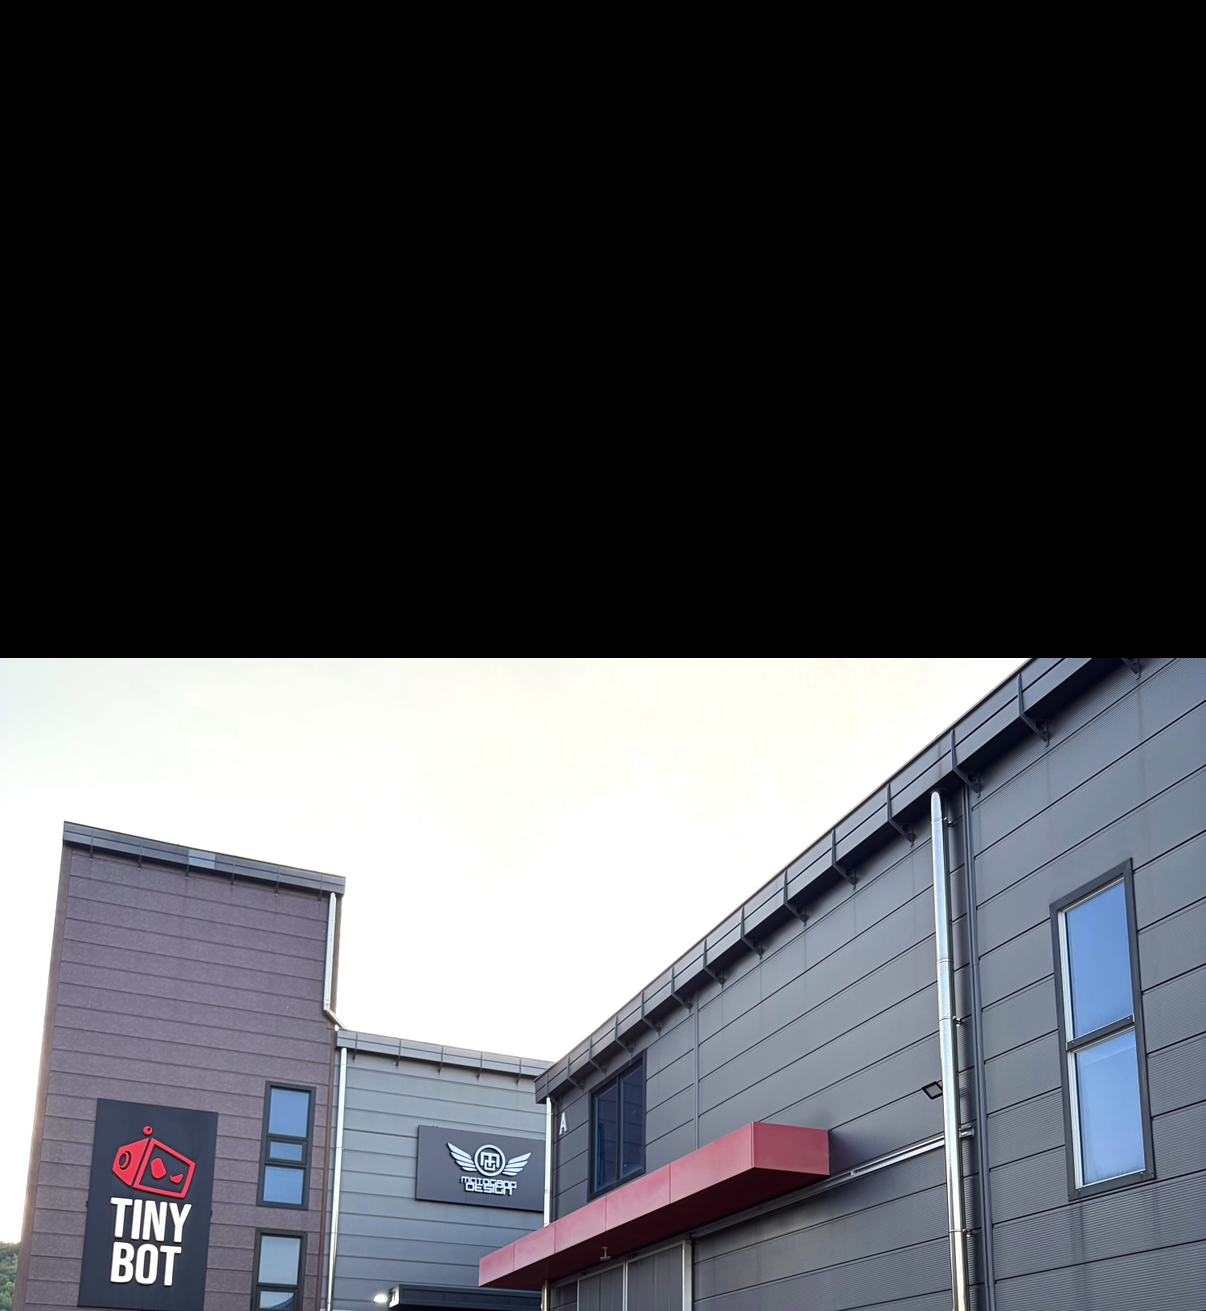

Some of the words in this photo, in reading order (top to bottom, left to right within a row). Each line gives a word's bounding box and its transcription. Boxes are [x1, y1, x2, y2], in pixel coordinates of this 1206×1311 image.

[559, 1112, 568, 1136] A
[465, 1182, 513, 1196] DESIGN
[110, 1197, 192, 1243] TINY
[110, 1241, 182, 1286] BOT
